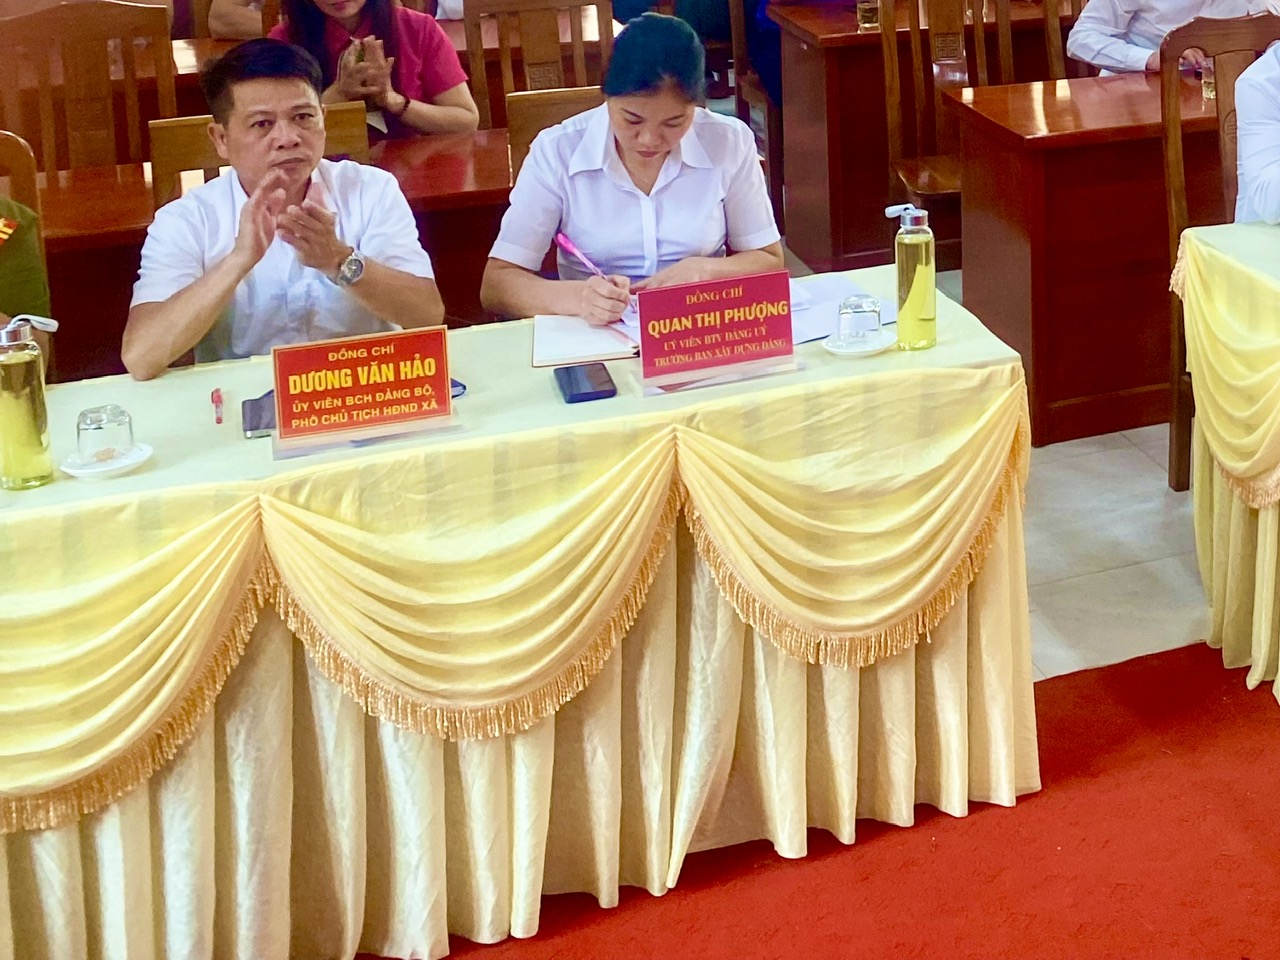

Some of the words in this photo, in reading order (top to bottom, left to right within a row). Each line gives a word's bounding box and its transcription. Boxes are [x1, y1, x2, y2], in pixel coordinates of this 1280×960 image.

[686, 288, 719, 305] ĐỒNG
[722, 284, 743, 299] CHÍ
[648, 315, 692, 339] QUAN
[695, 311, 721, 329] THỊ
[724, 300, 788, 324] PHƯỢNG
[328, 347, 368, 362] ĐỒNG
[371, 342, 395, 356] CHÍ
[679, 335, 702, 348] VIÊN
[704, 333, 722, 345] BTV
[694, 350, 713, 362] BAN
[288, 368, 353, 394] DƯƠNG
[357, 361, 395, 386] VĂN
[399, 353, 436, 380] HẢO
[292, 400, 309, 413] ỦY
[313, 396, 342, 410] VIÊN
[345, 393, 372, 406] BCH
[375, 387, 411, 402] ĐẢNG
[291, 414, 318, 429] PHÓ
[321, 409, 348, 425] CHỦ
[351, 407, 380, 421] TỊCH
[383, 402, 418, 416] HĐND
[421, 398, 438, 411] XÃ
